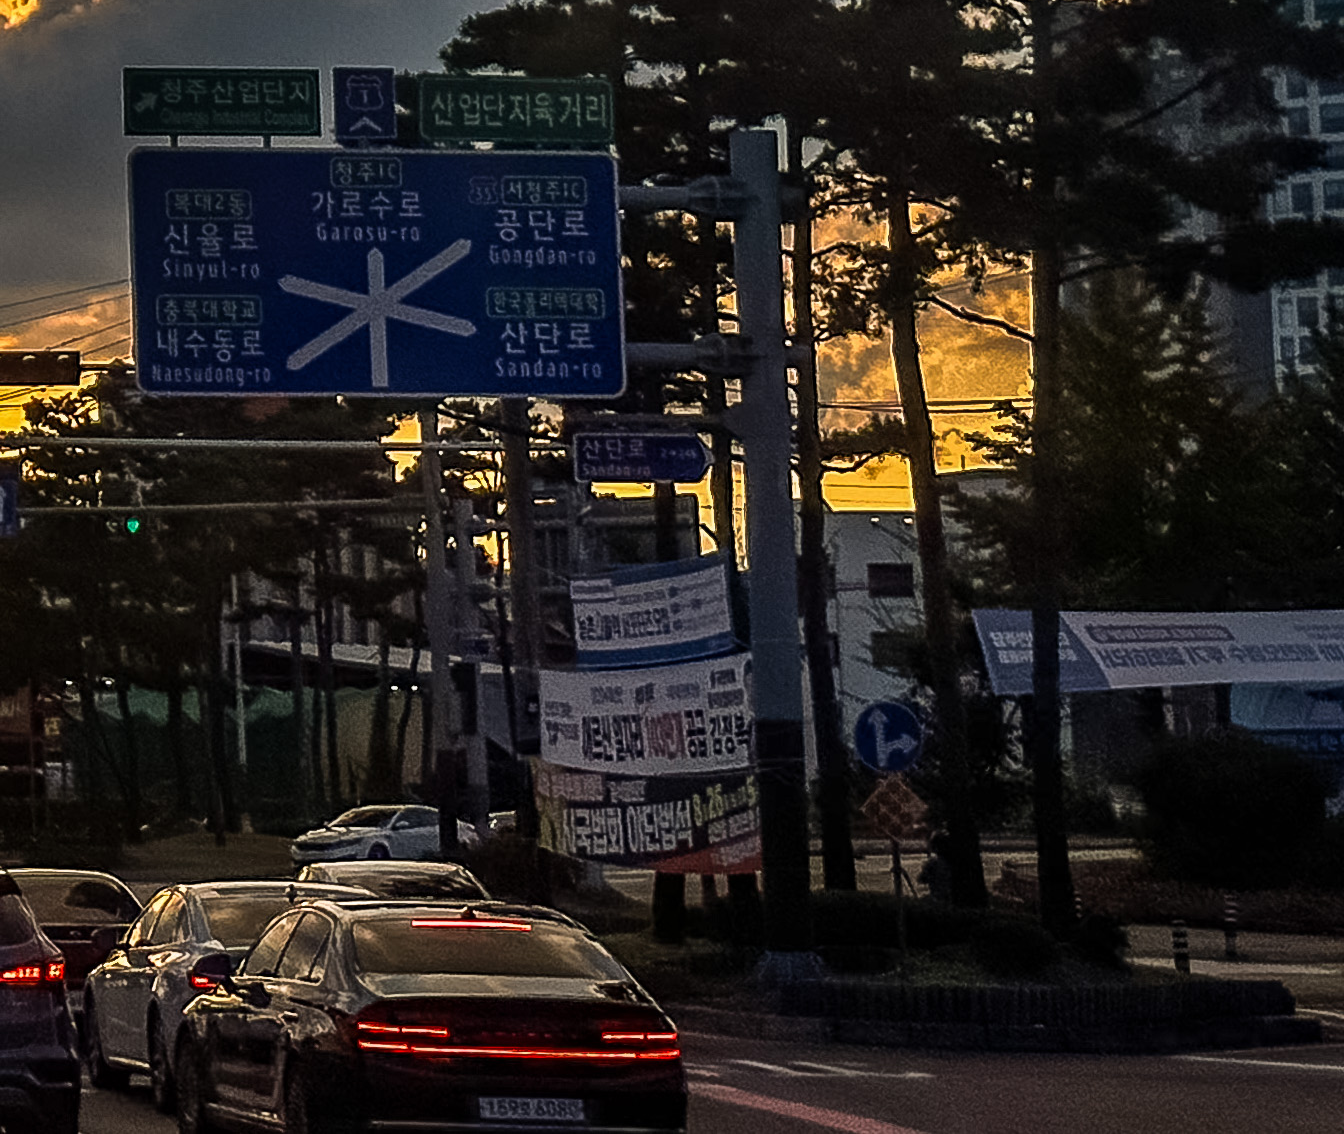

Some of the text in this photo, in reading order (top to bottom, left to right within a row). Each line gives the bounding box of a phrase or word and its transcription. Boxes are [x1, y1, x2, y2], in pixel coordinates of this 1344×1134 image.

[161, 79, 311, 104] 청주산업단지
[431, 93, 607, 128] 산업단지육거리
[335, 160, 397, 184] 청주IC
[505, 177, 581, 200] 서청주IC
[173, 193, 245, 215] 복대2동
[312, 192, 424, 220] 가로수로
[316, 223, 420, 242] Garosu-ro
[494, 210, 589, 242] 공단로
[164, 223, 258, 255] 신율로
[489, 246, 596, 268] Gongdan-ro
[163, 259, 260, 280] Sinyul-ro
[163, 299, 256, 321] 충북대학교
[492, 292, 599, 314] 한국폴리텍대학
[157, 329, 265, 363] 내수동로
[499, 322, 594, 354] 산단로
[152, 366, 270, 386] Naesudong-ro
[495, 359, 602, 378] Sandan-ro
[583, 439, 646, 460] 산단로
